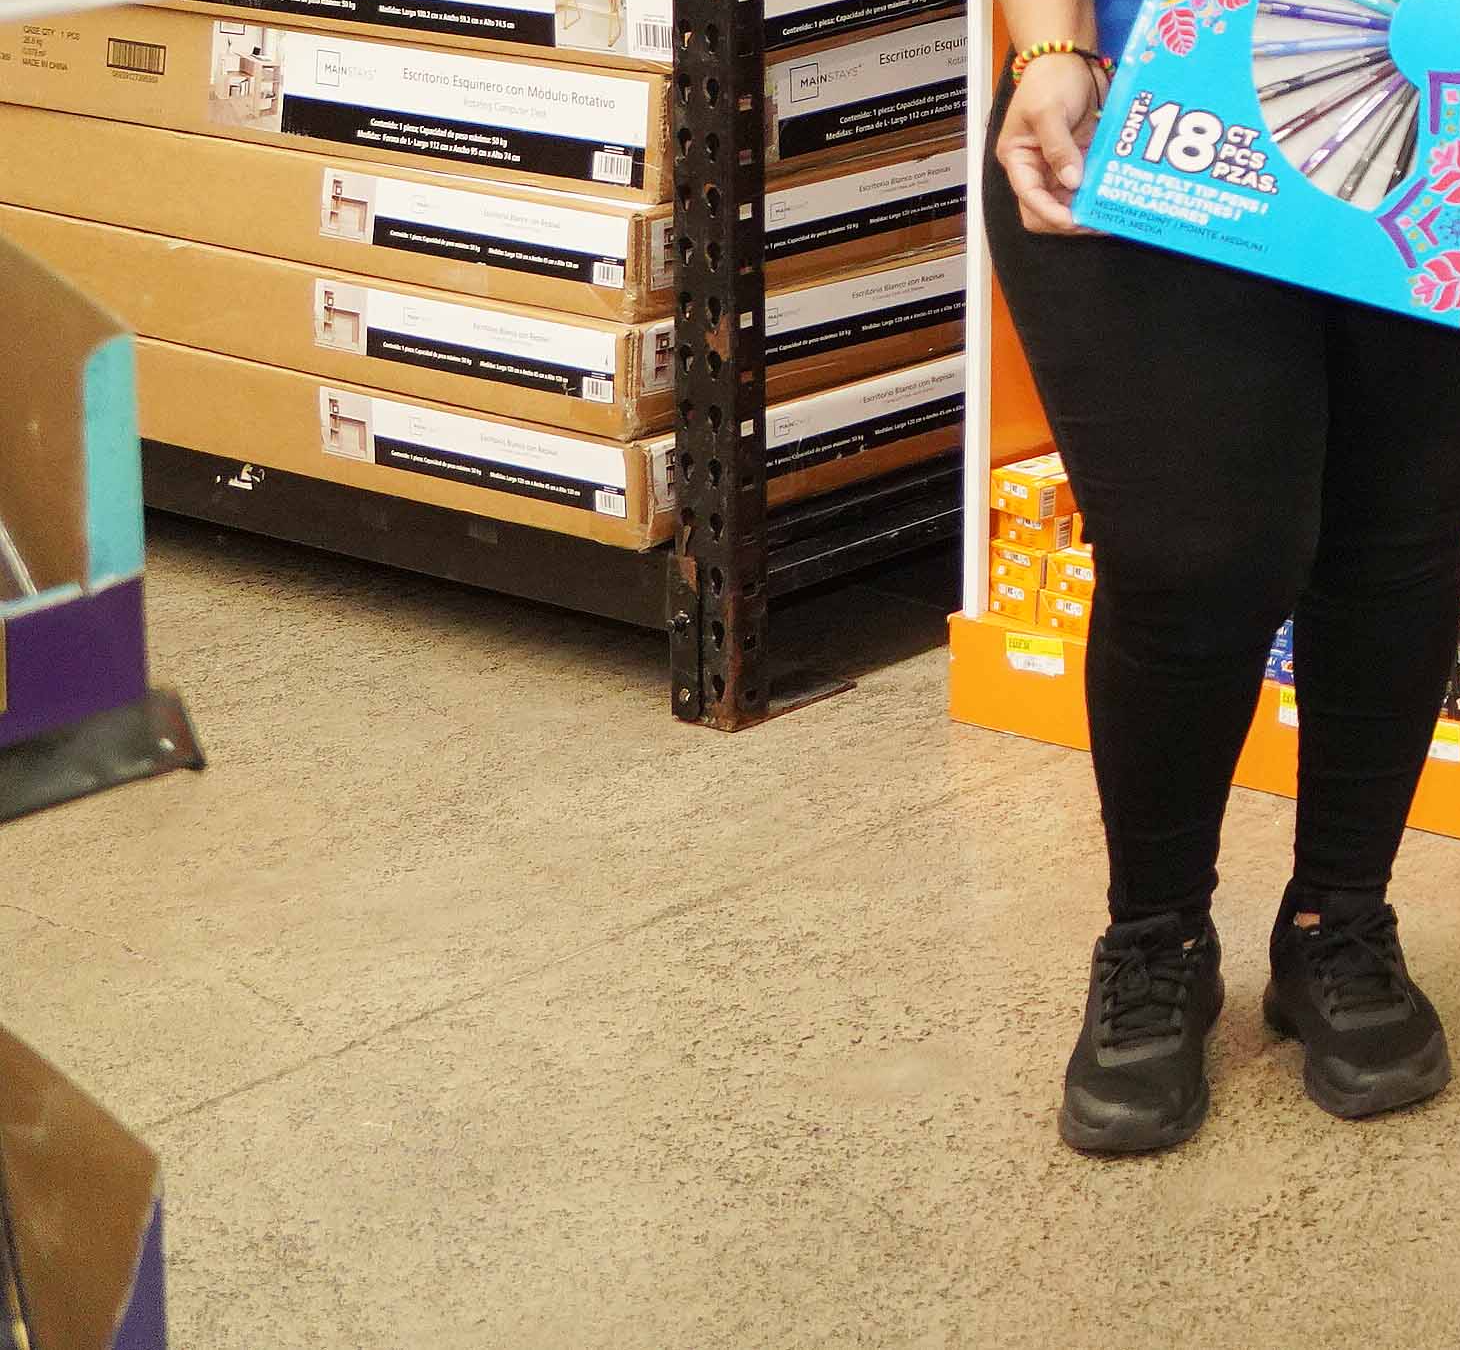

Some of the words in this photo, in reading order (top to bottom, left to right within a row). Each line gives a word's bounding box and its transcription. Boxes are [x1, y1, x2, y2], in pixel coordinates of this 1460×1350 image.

[800, 66, 858, 89] MAINSTAYS
[879, 44, 931, 65] Escritorio
[403, 68, 450, 86] Escritorio
[453, 74, 502, 96] Esquinero
[505, 81, 524, 95] con
[527, 80, 567, 103] Módulo
[571, 90, 615, 109] Rotativo
[1143, 102, 1223, 173] 18
[1228, 126, 1260, 145] CT
[1221, 143, 1267, 170] PCS
[1211, 162, 1278, 194] PZAS.
